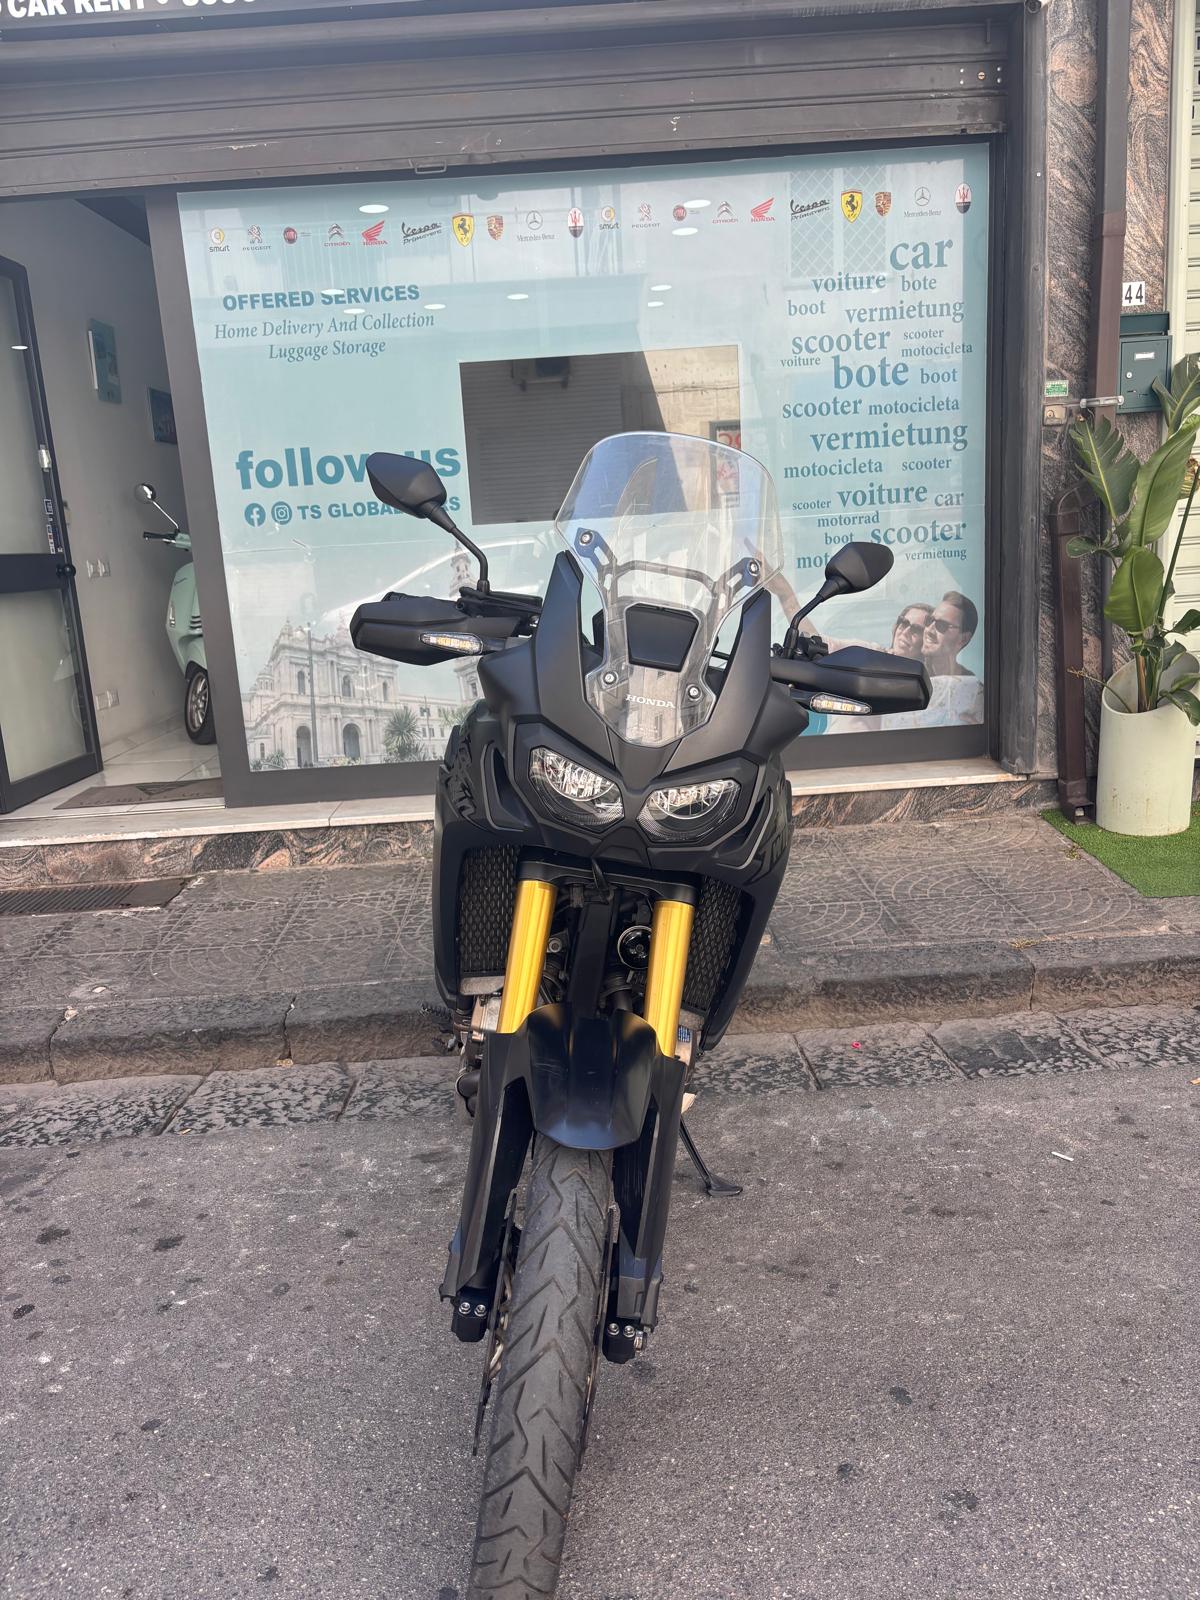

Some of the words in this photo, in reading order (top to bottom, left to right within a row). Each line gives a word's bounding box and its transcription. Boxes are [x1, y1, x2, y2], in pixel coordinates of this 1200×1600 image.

[8, 0, 67, 18] CAR
[790, 199, 830, 216] Vespa
[401, 221, 442, 238] Vespa
[599, 223, 620, 231] smart
[209, 244, 230, 253] smart
[890, 239, 953, 271] car
[812, 271, 886, 293] voiture
[901, 275, 937, 292] bote
[222, 290, 314, 311] OFFERED
[321, 284, 420, 306] SERVICES
[1124, 284, 1144, 304] 44
[788, 299, 826, 316] boot
[845, 300, 965, 324] vermietung
[214, 323, 258, 340] Home
[262, 319, 324, 338] Delivery
[327, 314, 358, 333] And
[362, 311, 435, 331] Collection
[903, 328, 944, 340] scooter
[791, 327, 891, 355] scooter
[901, 342, 973, 358] motocicleta
[269, 343, 328, 363] Luggage
[333, 339, 386, 358] Storage
[780, 355, 821, 367] voiture
[832, 354, 909, 390] bote
[920, 368, 958, 384] boot
[782, 396, 863, 419] scooter
[868, 395, 960, 416] motocicleta
[810, 422, 968, 452] vermietung
[783, 457, 883, 479] motocicleta
[901, 458, 952, 472] scooter
[836, 482, 928, 508] voiture
[934, 492, 965, 507] car
[297, 504, 322, 520] TS
[327, 501, 403, 519] GLOBA
[792, 499, 832, 511] scooter
[817, 510, 880, 528] motorrad
[824, 532, 855, 545] boot
[870, 519, 967, 545] scooter
[905, 548, 967, 561] vermietung
[625, 694, 676, 709] HONDA
